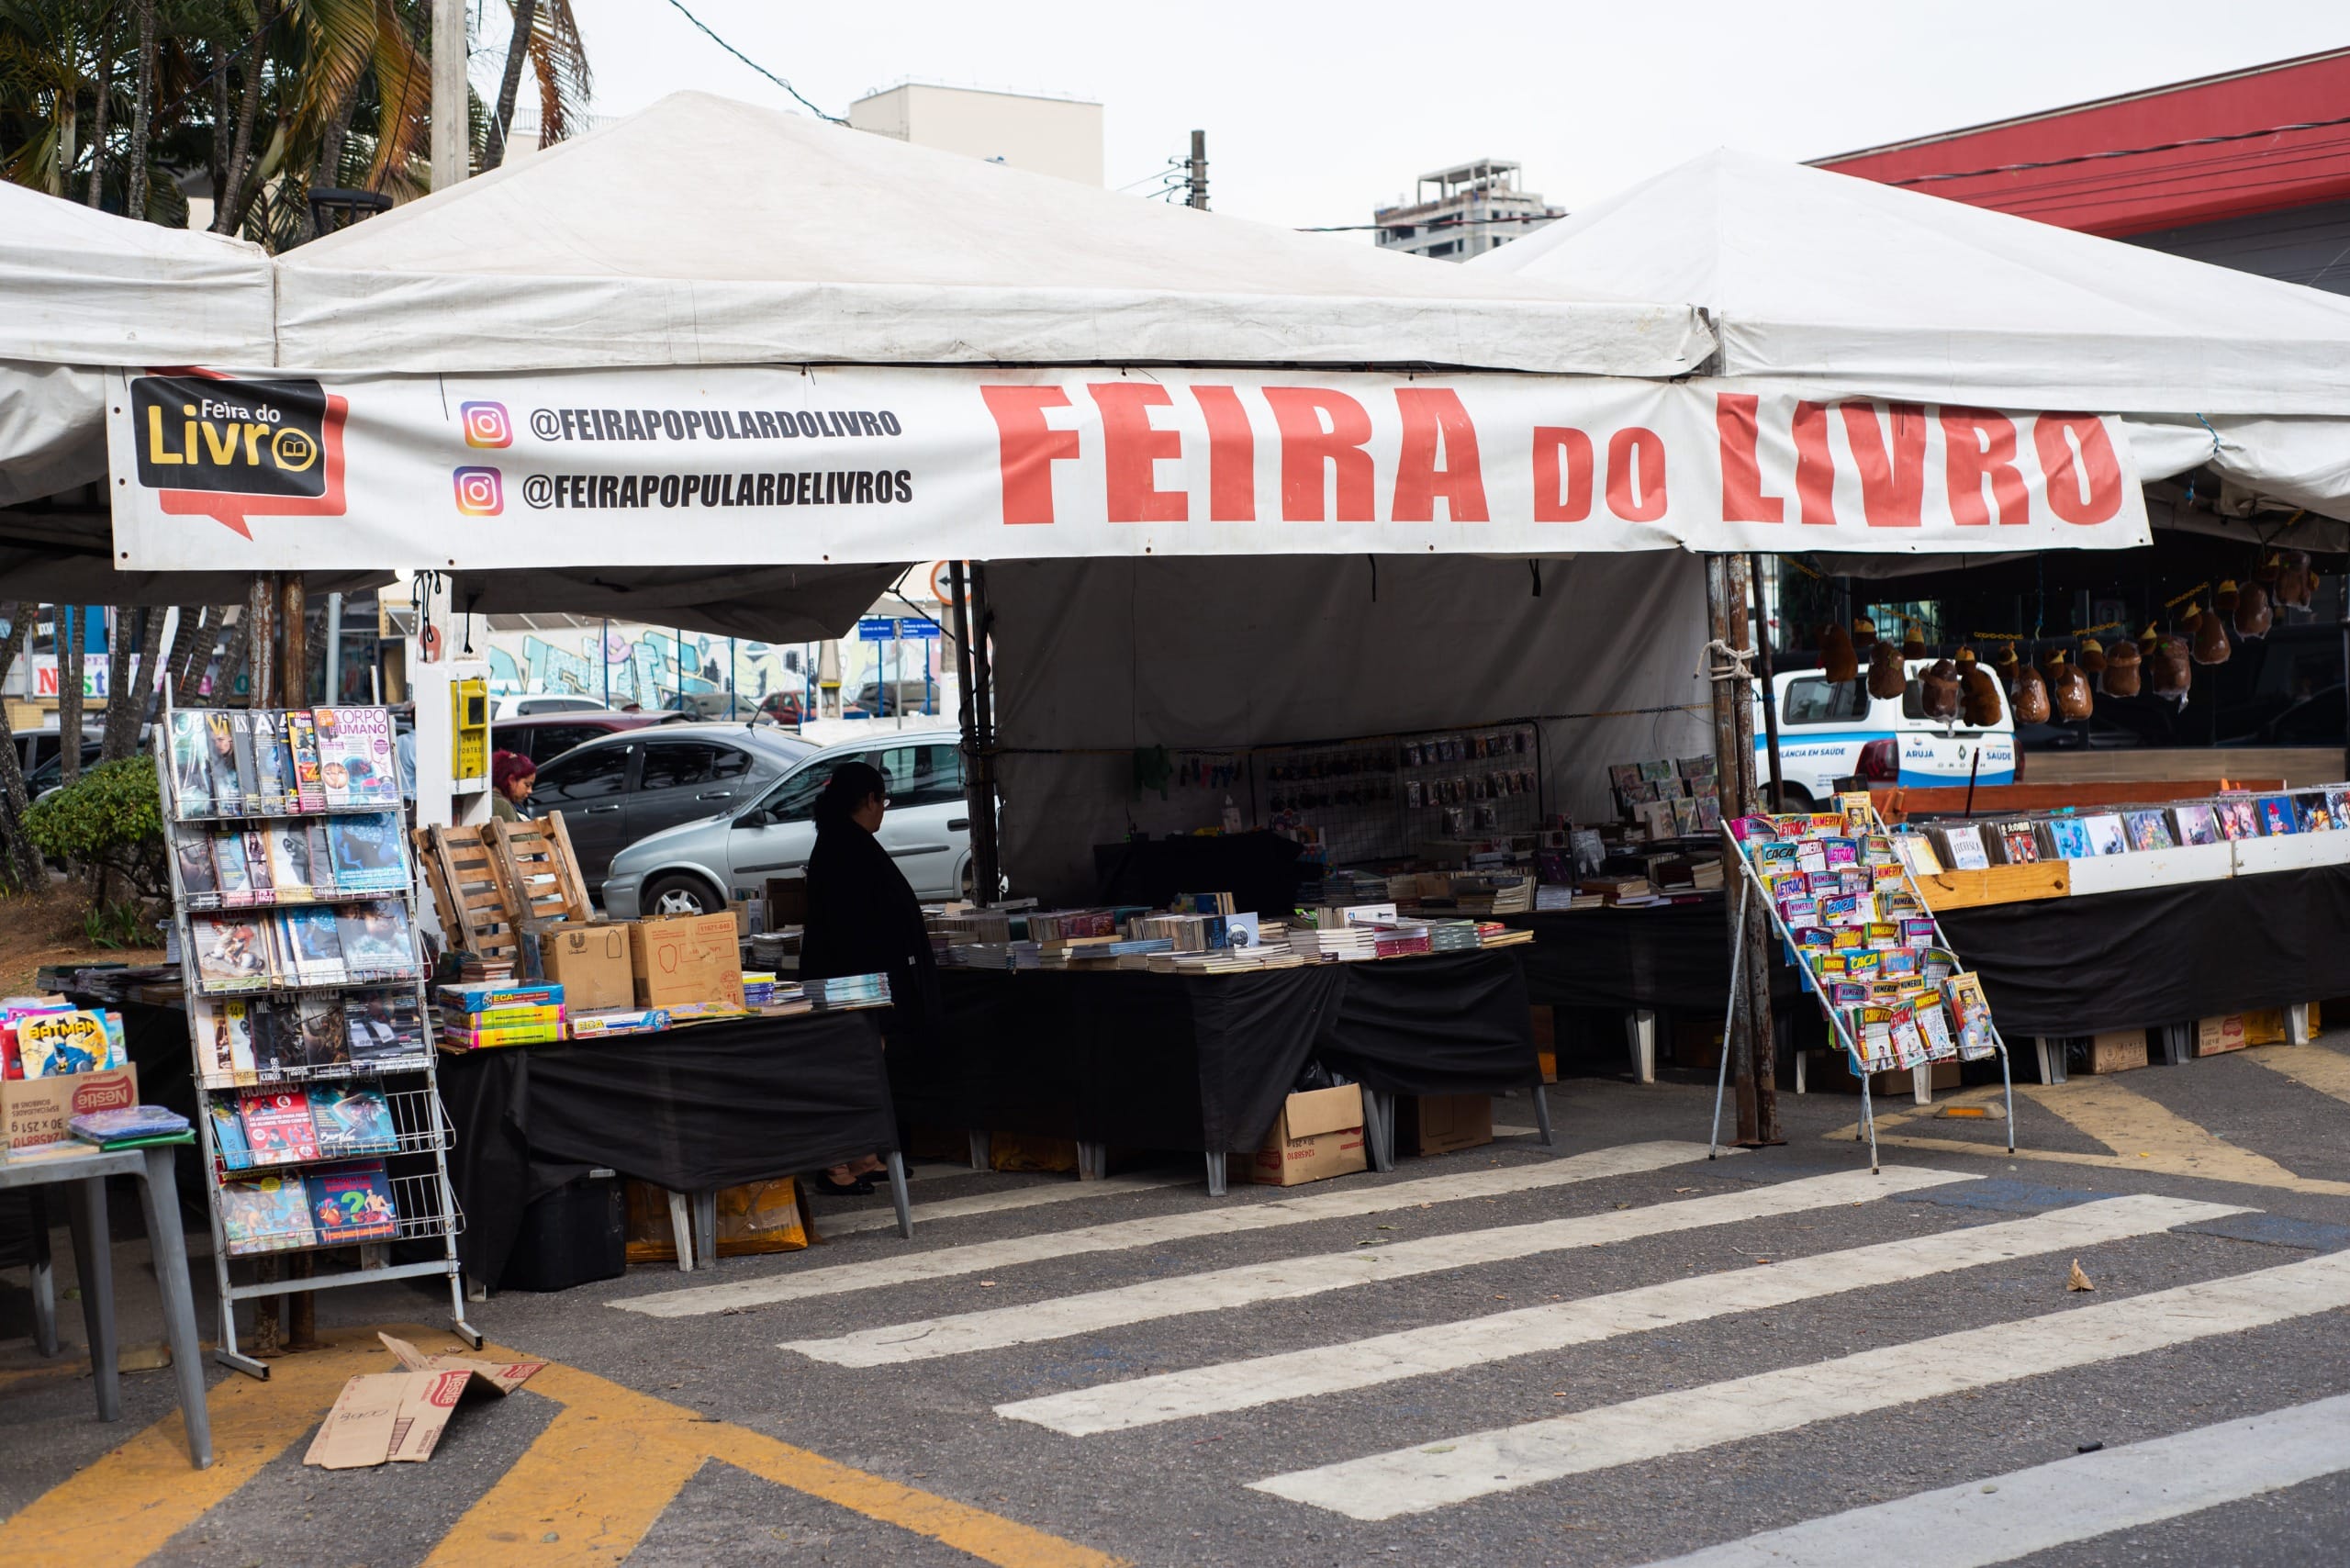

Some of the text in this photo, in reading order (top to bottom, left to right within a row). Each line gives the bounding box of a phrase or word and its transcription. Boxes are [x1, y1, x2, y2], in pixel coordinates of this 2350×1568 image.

[201, 398, 281, 423] Feira do
[530, 408, 903, 442] @FEIRAPOPULARDOLIVRO
[148, 404, 318, 472] Livro
[980, 382, 2122, 527] FEIRA DO LIVRO
[522, 469, 913, 510] @FEIRAPOPULARDELIVROS
[333, 709, 386, 724] CORPO
[330, 723, 387, 734] HUMANO
[1807, 748, 1819, 757] EM
[1819, 746, 1846, 757] SAÚDE
[1906, 748, 1934, 758] ARUJÁ
[1986, 750, 2012, 761] SAÚDE
[1811, 814, 1841, 827] NUMERIX
[1877, 865, 1904, 878] NUMERIX
[1791, 902, 1815, 912] NUMERIX
[1874, 983, 1898, 993] NUMERIX
[1900, 976, 1922, 989] NUMERIX
[493, 993, 514, 1002] ECA
[1915, 991, 1940, 1007] NUMERIX
[1864, 1008, 1892, 1022] CRIPTO
[28, 1021, 98, 1039] BATMAN
[576, 1019, 605, 1031] ECA
[78, 1086, 129, 1109] Nestlé
[21, 1121, 40, 1132] 251
[50, 1118, 63, 1129] 30
[1287, 1148, 1315, 1161] 12458810
